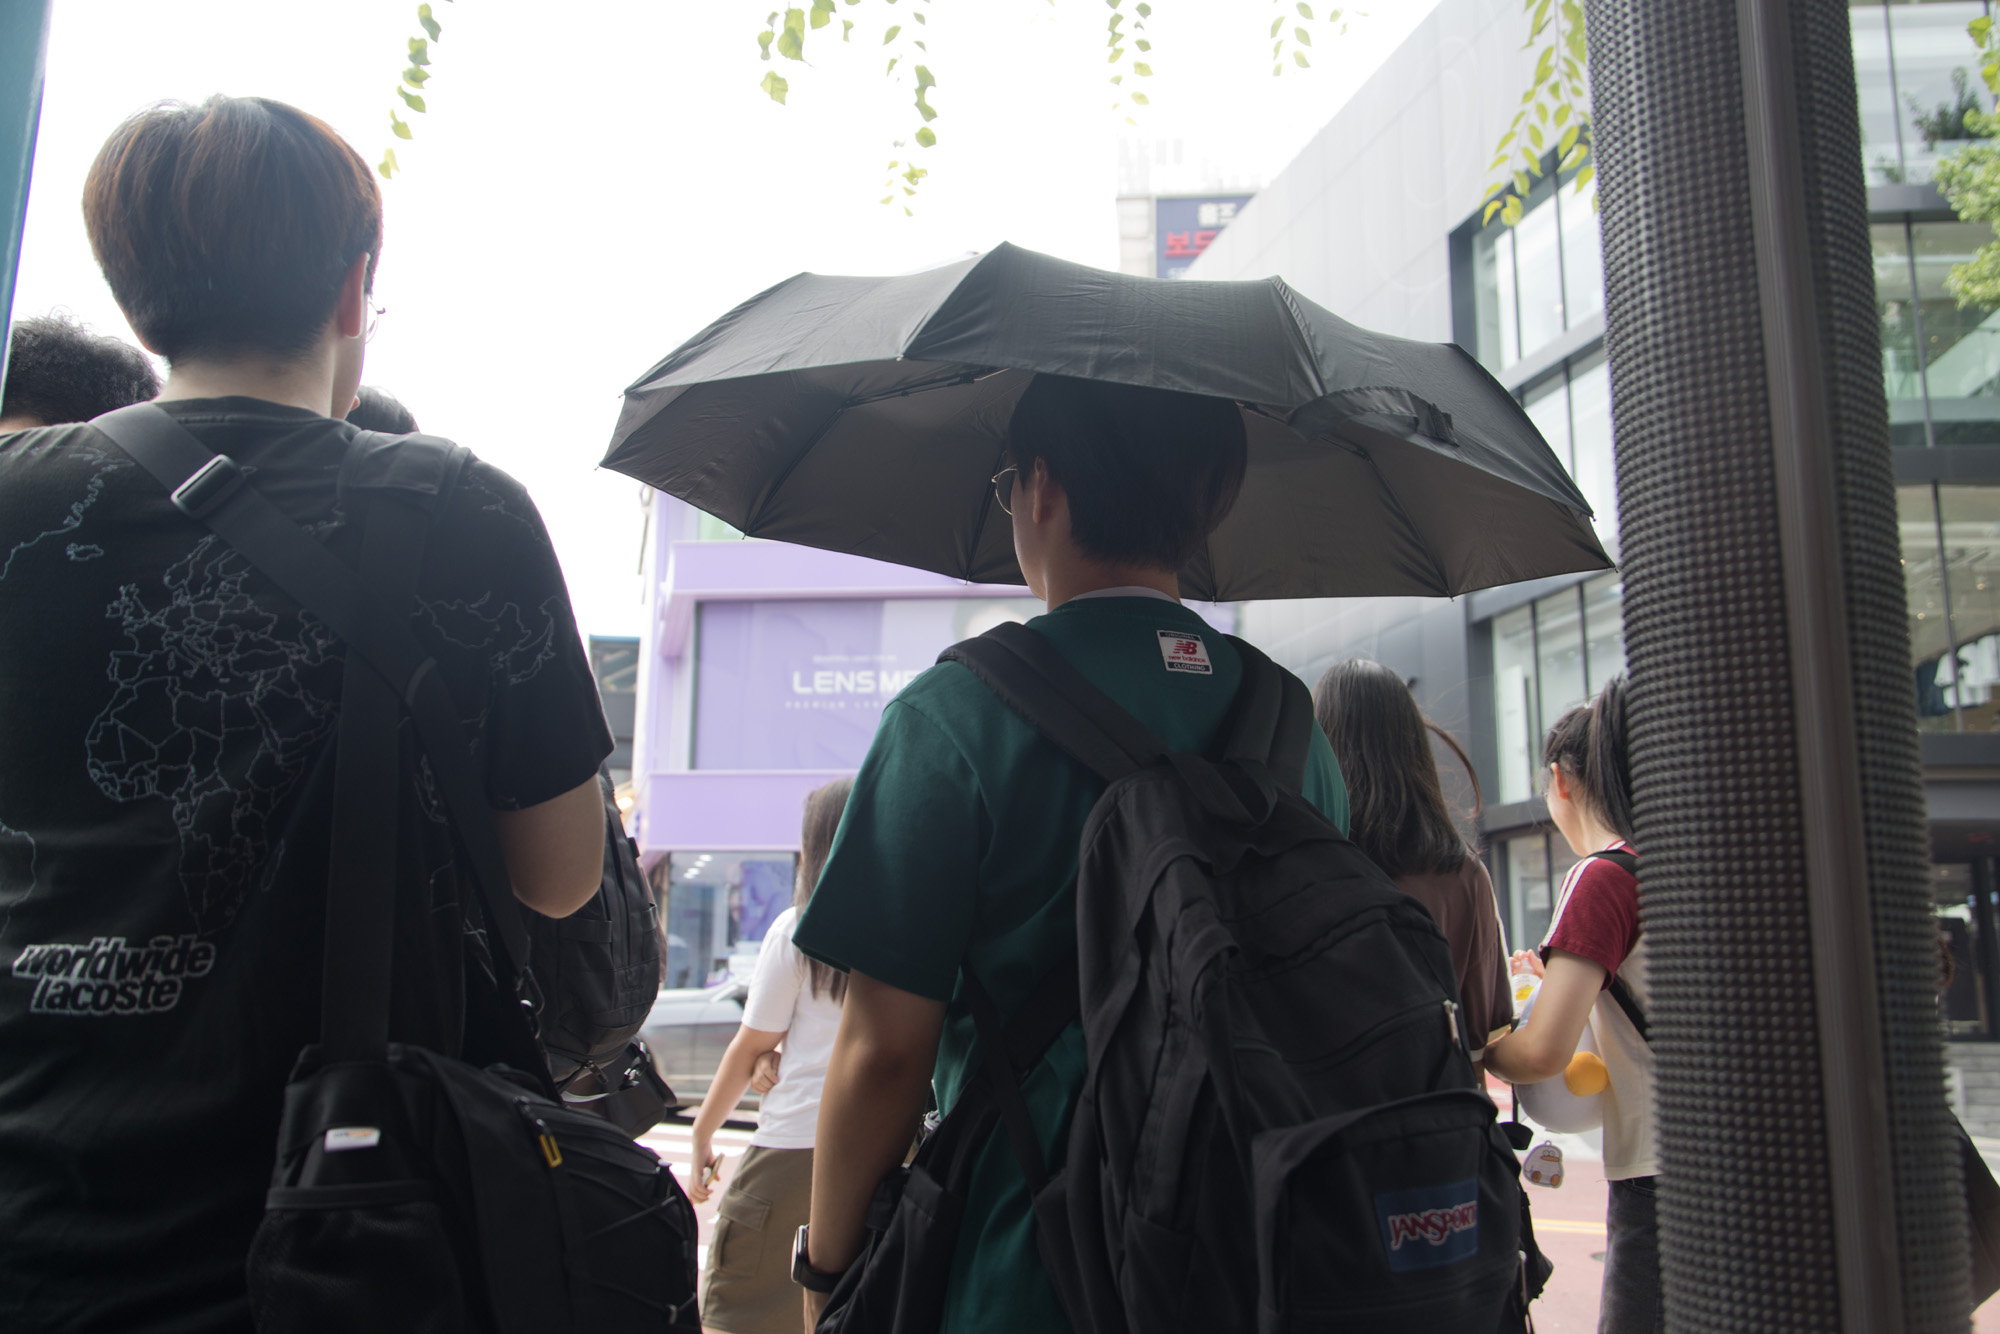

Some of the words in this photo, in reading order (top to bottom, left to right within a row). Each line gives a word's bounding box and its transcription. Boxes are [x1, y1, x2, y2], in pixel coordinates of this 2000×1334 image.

[1173, 662, 1206, 671] CLOTHING
[1182, 655, 1206, 663] balance
[12, 935, 216, 980] worldwide
[30, 975, 182, 1015] lacoste
